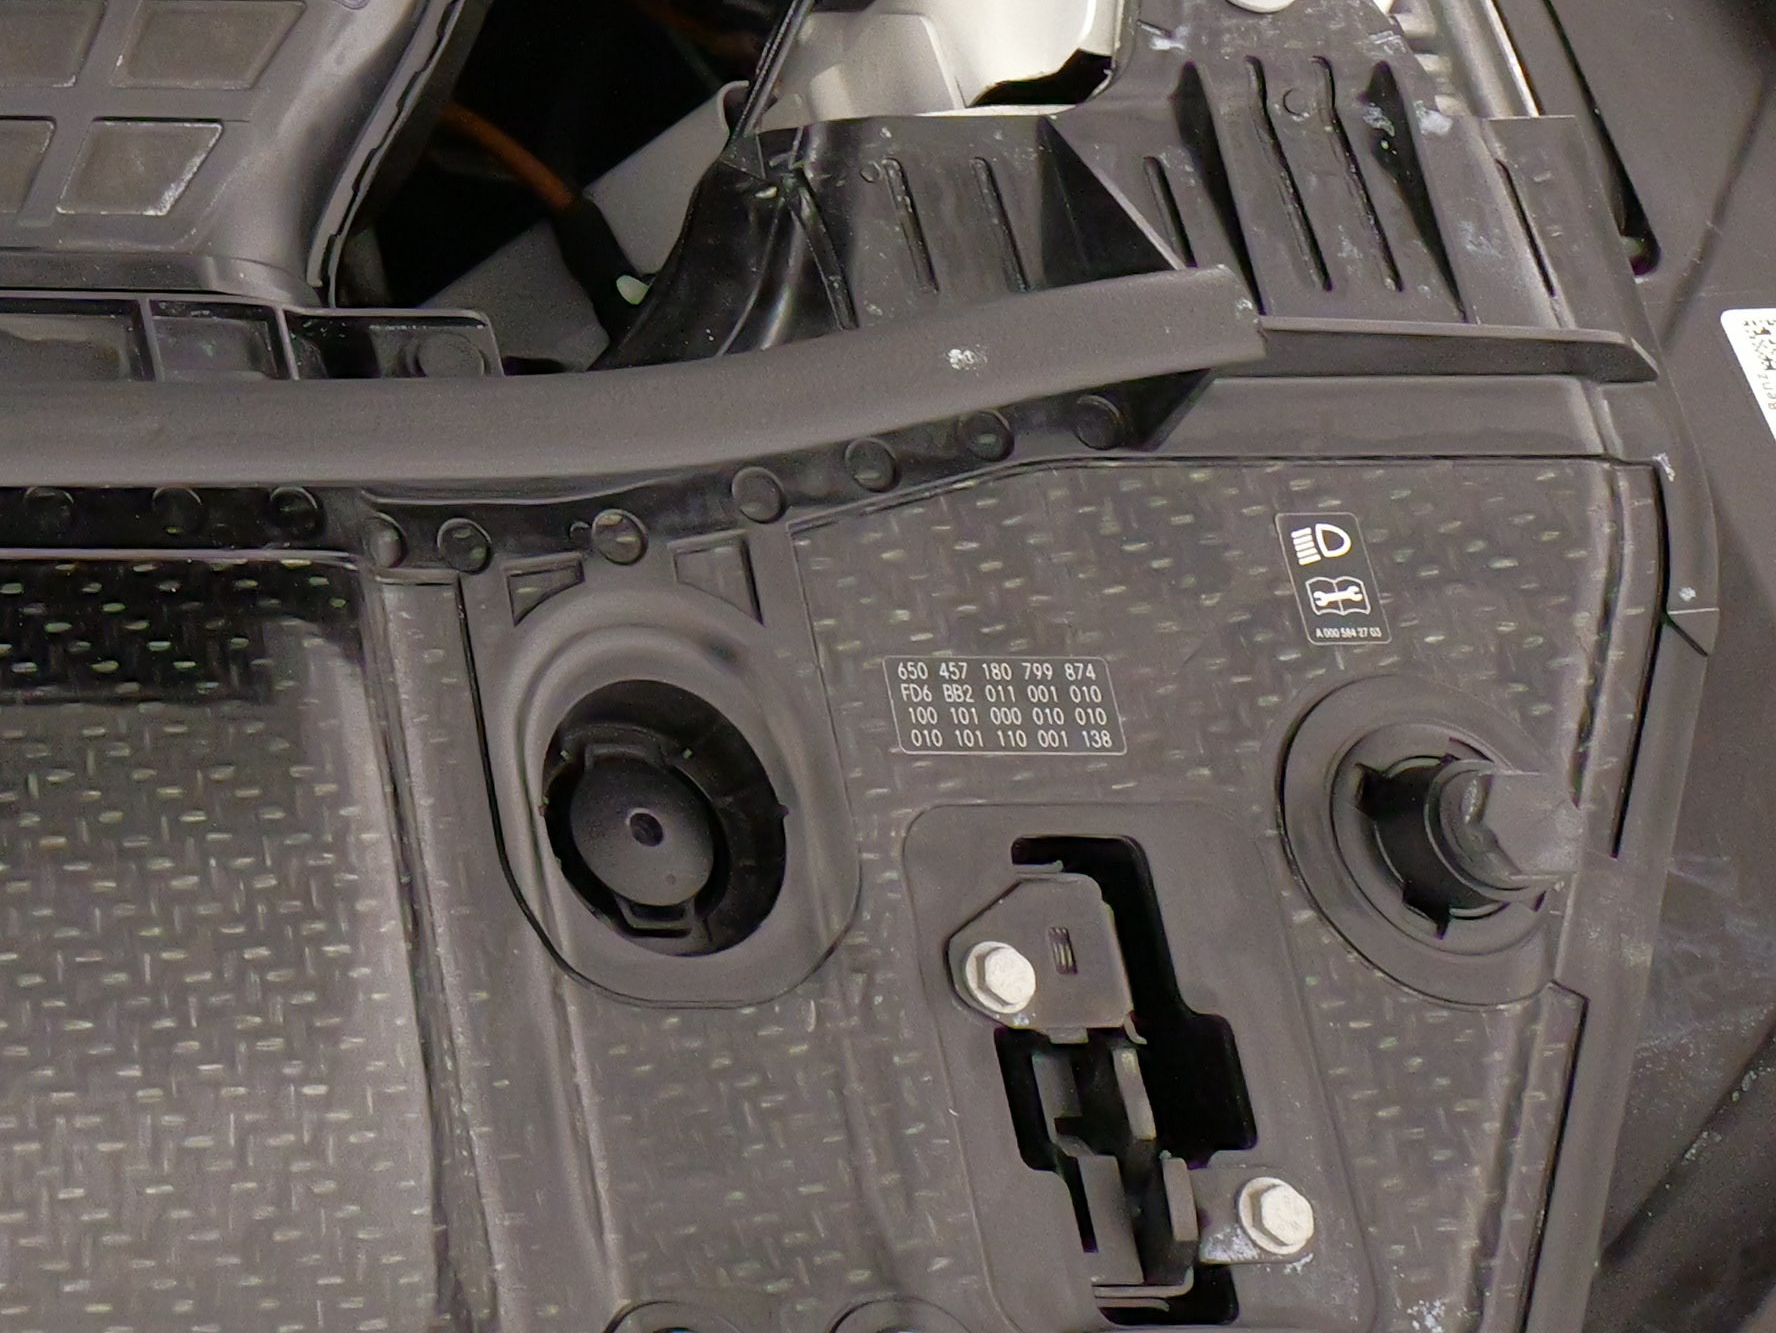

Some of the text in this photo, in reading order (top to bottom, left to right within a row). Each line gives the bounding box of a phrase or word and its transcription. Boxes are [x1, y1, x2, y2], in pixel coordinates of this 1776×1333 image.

[1315, 627, 1324, 638] A
[898, 662, 1096, 681] 650 457 180 799 874
[901, 684, 1101, 703] FD6 BB2 011 001 010
[908, 707, 1107, 726] 100 101 000 010 010
[911, 729, 1112, 748] 010 101 110 001 138
